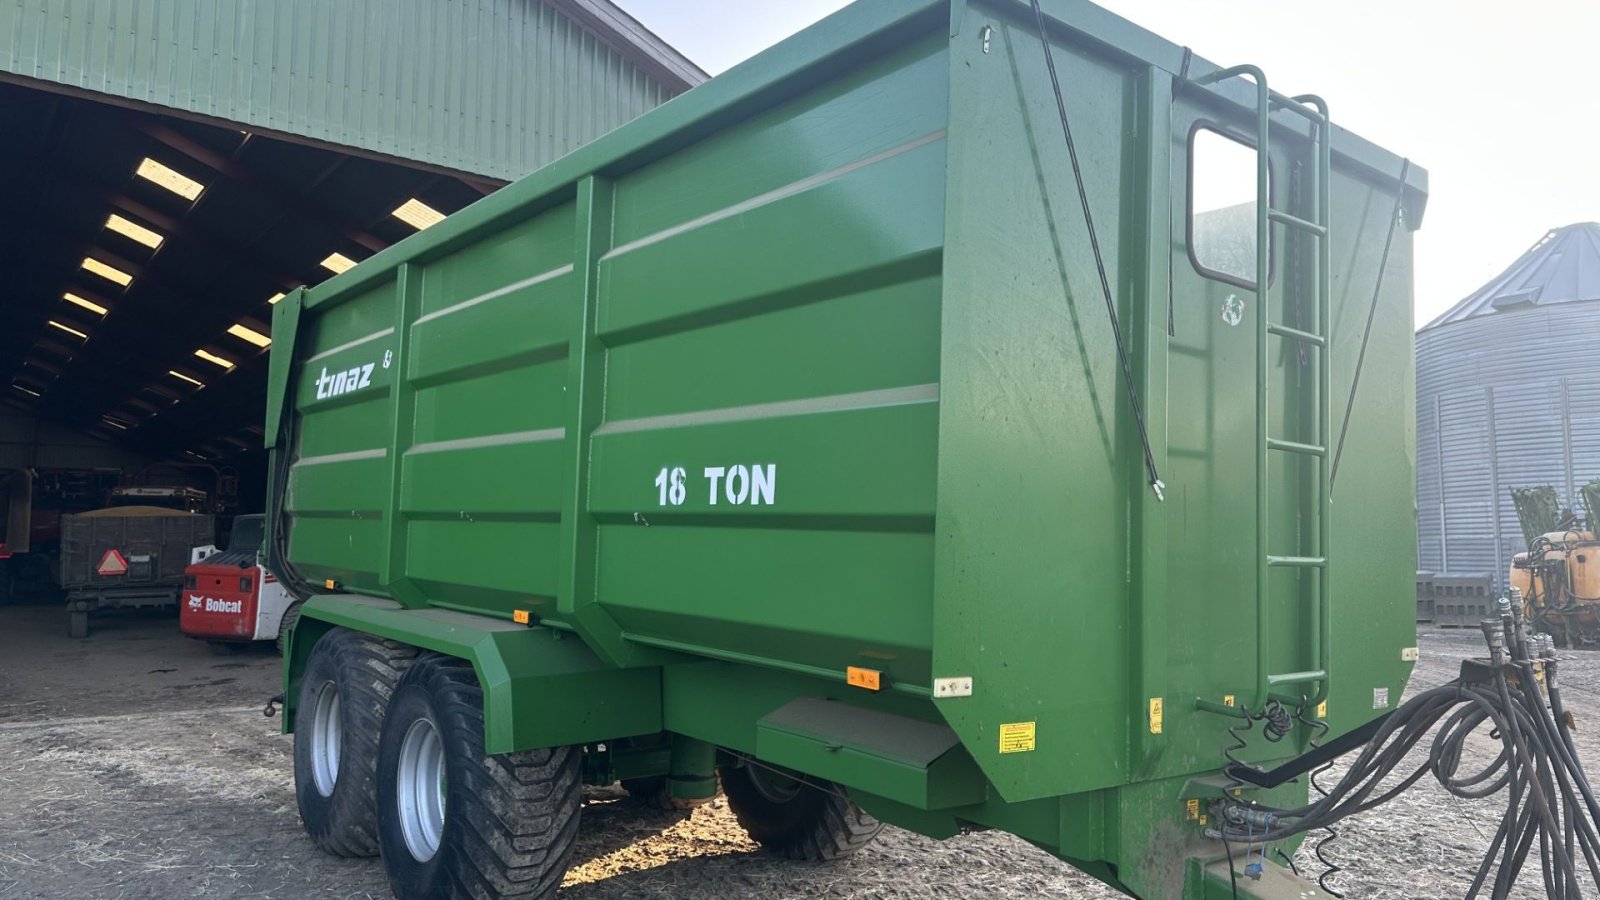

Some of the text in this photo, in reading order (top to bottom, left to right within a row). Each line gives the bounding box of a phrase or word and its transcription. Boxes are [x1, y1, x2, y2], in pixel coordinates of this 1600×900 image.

[655, 464, 776, 506] 18 TON
[205, 597, 242, 613] Bobcat
